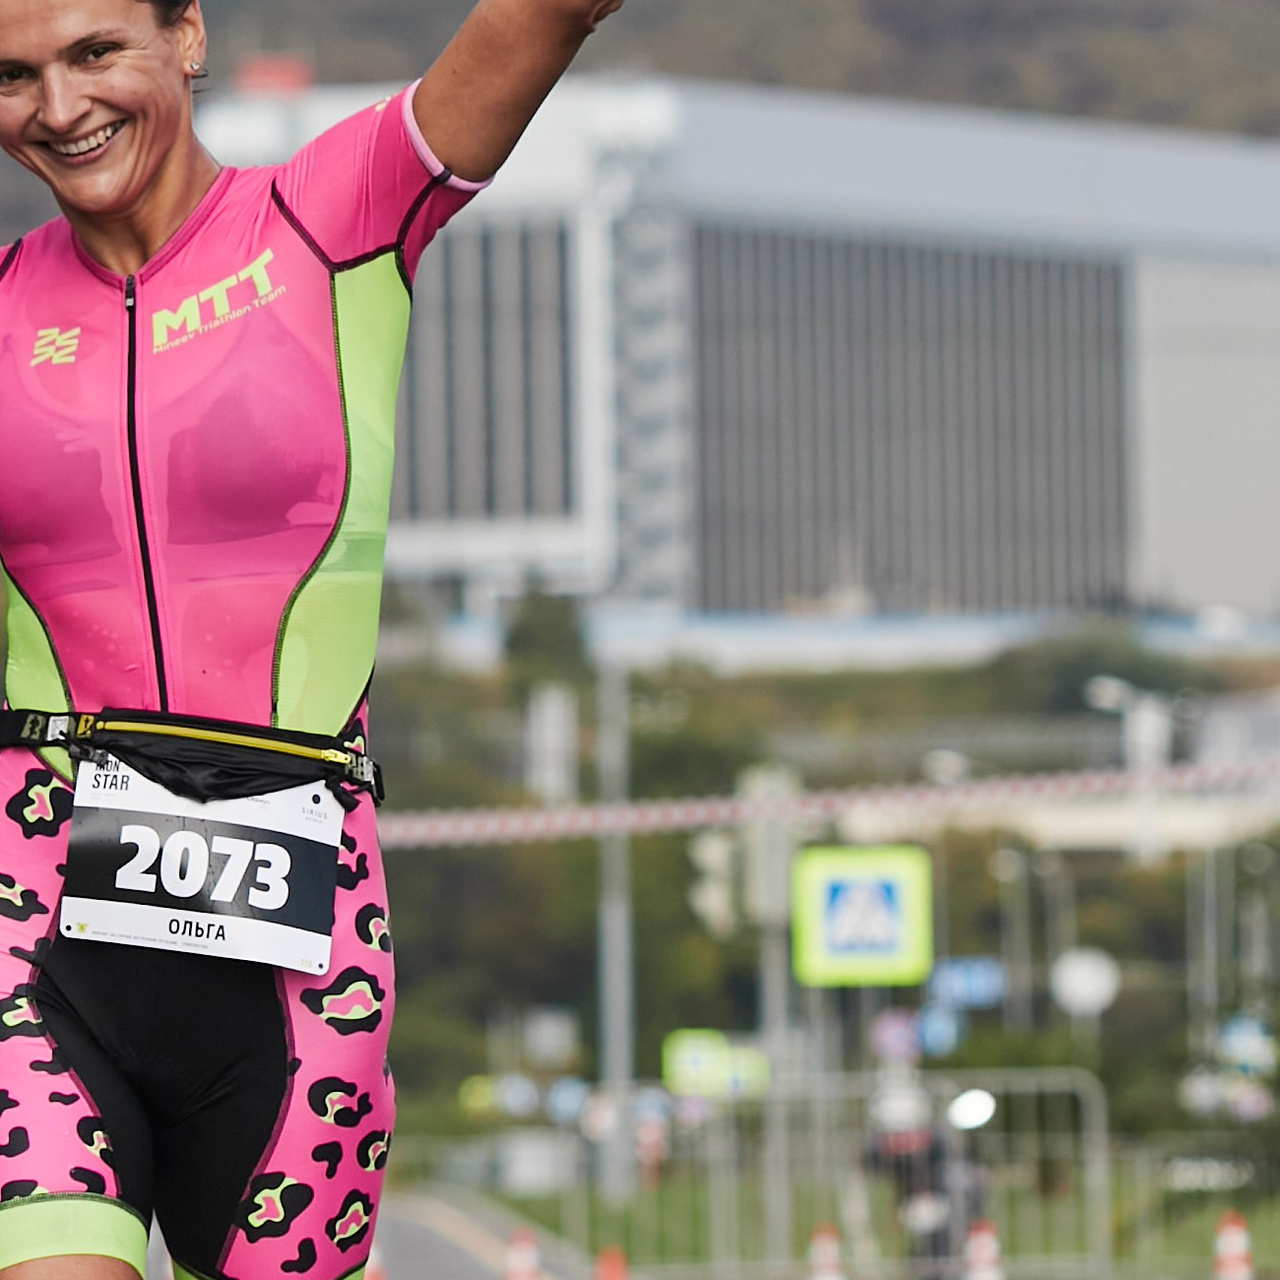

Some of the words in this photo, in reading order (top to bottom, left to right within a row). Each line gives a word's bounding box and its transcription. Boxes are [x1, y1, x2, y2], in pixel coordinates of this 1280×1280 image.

[152, 247, 274, 348] MTT
[199, 305, 251, 334] Triathlon
[253, 285, 287, 309] Team
[92, 773, 130, 791] STAR
[302, 806, 328, 820] SIRIUS
[115, 824, 291, 910] 2073
[168, 918, 226, 941] ОЛЬГА
